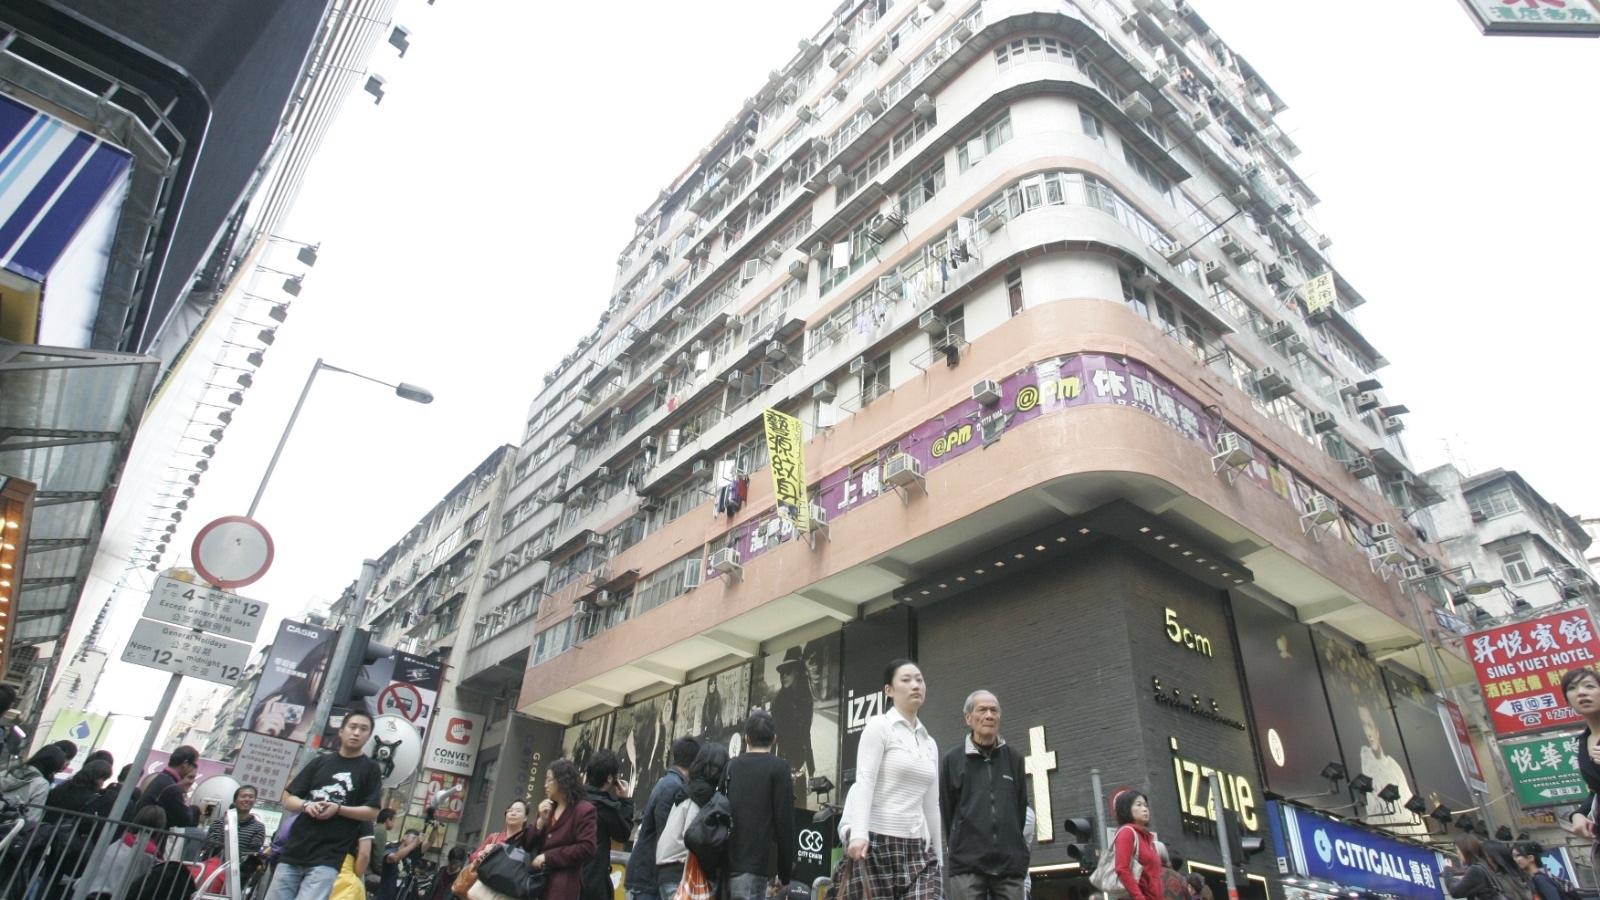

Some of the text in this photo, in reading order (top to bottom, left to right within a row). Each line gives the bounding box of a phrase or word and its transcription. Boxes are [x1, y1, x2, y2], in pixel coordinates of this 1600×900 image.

[159, 600, 251, 627] Except General Holidays
[182, 588, 195, 601] 4
[241, 602, 260, 617] 12
[162, 627, 227, 649] General Holidays
[286, 624, 319, 639] CASIO
[1164, 607, 1214, 658] 5cm
[130, 641, 152, 652] Noon
[152, 649, 173, 665] 12
[186, 655, 220, 668] midnight
[221, 665, 240, 681] 12
[1486, 648, 1594, 679] SING YUET HOTEL
[434, 747, 472, 762] CONVEY
[525, 752, 541, 805] GIORDA
[1169, 736, 1259, 831] izzue
[797, 850, 808, 858] CITY
[1334, 839, 1411, 882] CITICALL
